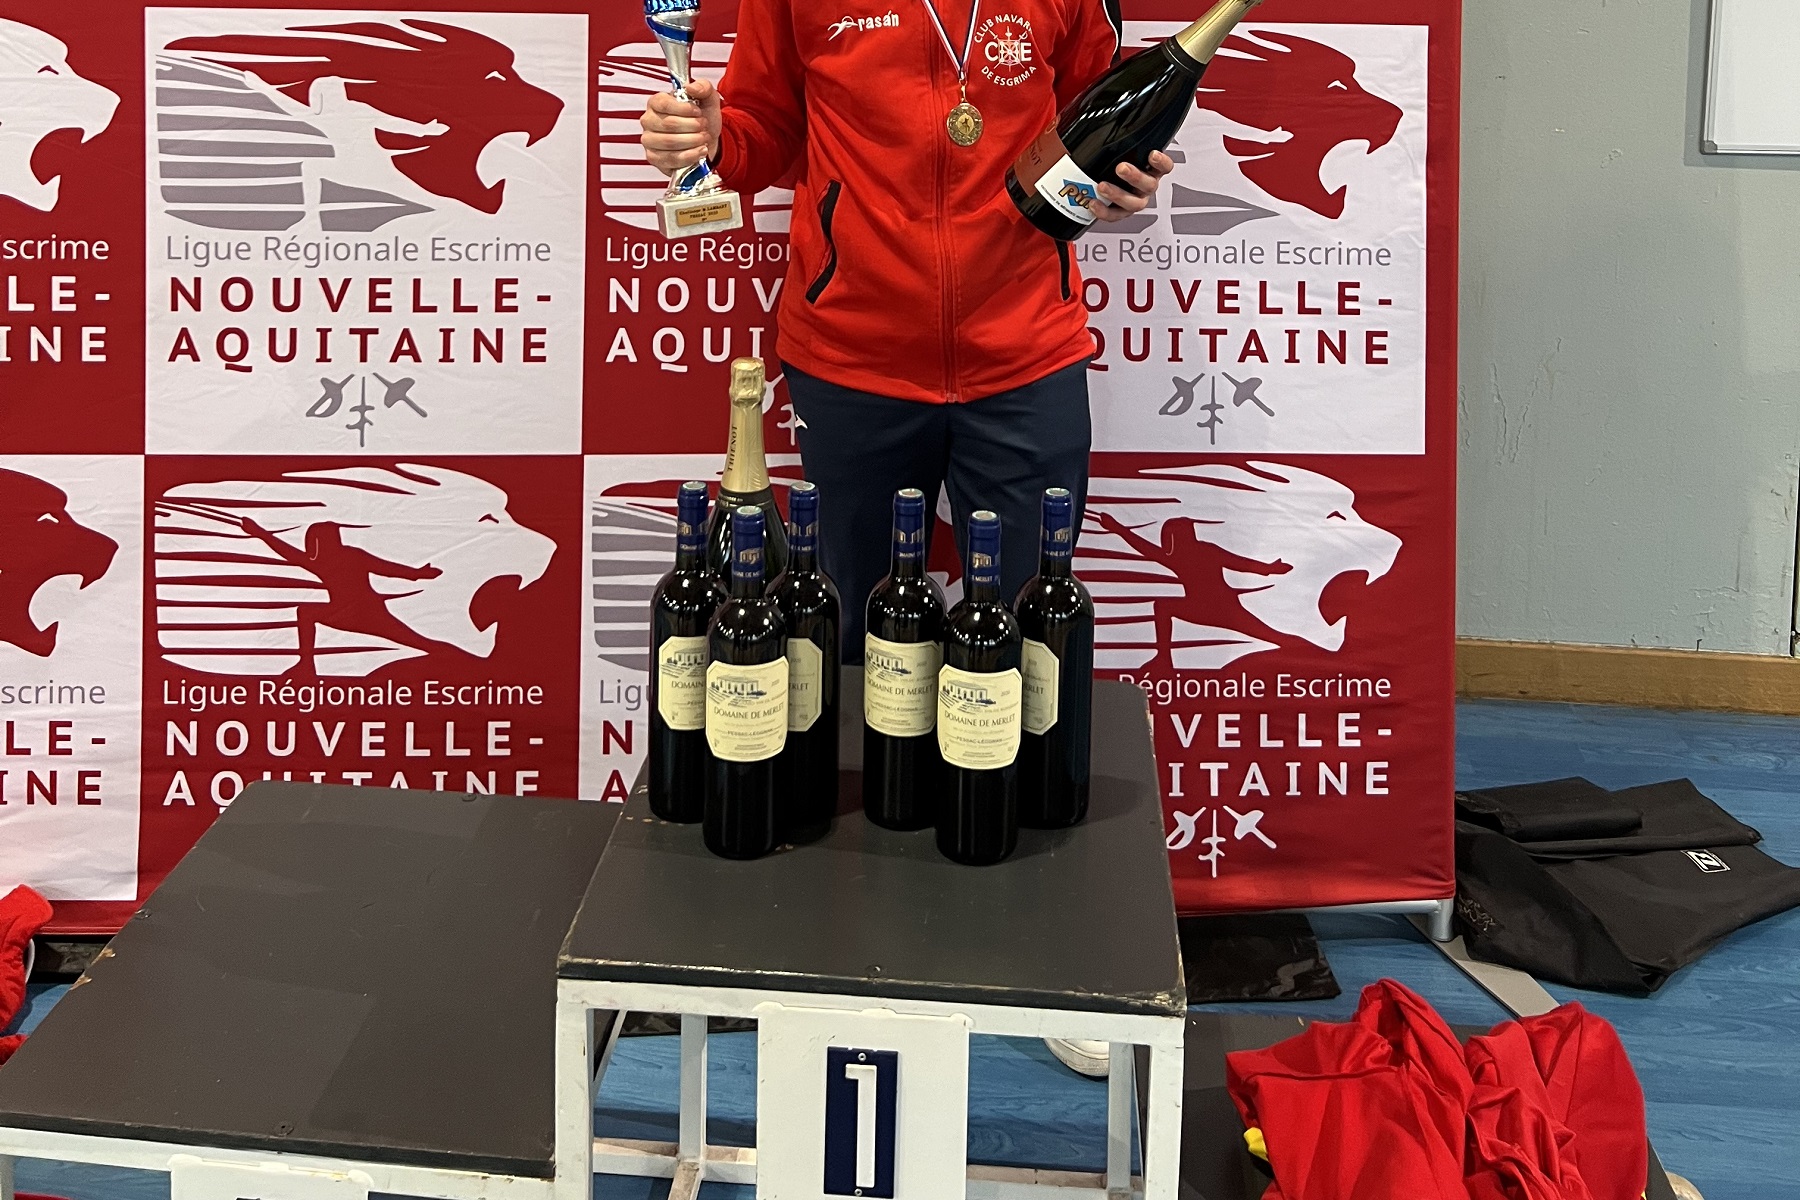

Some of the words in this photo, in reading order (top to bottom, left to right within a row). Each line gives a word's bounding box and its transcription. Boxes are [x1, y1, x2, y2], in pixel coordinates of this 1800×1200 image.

[974, 18, 994, 43] CLUB
[995, 13, 1033, 34] NAVAR
[981, 65, 994, 80] DE
[993, 66, 1037, 86] ESGRIMA
[0, 233, 110, 260] scrime
[166, 235, 252, 268] Ligue
[263, 234, 419, 269] Régionale
[431, 237, 552, 263] Escrime
[606, 237, 688, 270] Ligue
[700, 236, 790, 270] Régio
[1119, 237, 1265, 270] Régionale
[1276, 241, 1392, 266] Escrime
[8, 275, 110, 312] LE-
[170, 276, 552, 314] NOUVELLE-
[608, 277, 784, 313] NOUV
[1082, 277, 1393, 315] OUVELLE-
[0, 325, 107, 362] INE
[168, 326, 549, 373] AQUITAINE
[605, 327, 765, 373] AQUI
[1086, 326, 1389, 372] QUITAINE
[0, 679, 106, 704] scrime
[162, 679, 248, 713] Ligue
[259, 679, 411, 713] Régionale
[424, 682, 544, 706] Escrime
[600, 679, 650, 711] Lig
[672, 680, 704, 688] DOMAIN
[1277, 673, 1391, 698] Escrime
[714, 705, 749, 719] DOMAINE
[751, 711, 761, 719] DE
[763, 701, 784, 716] MERLET
[945, 710, 977, 726] DOMAINE
[992, 713, 1016, 726] MERLET
[6, 720, 106, 755] LE-
[166, 720, 544, 758] NOUVELLE-
[1149, 712, 1392, 748] VELLE-
[0, 770, 102, 806] INE
[1168, 761, 1389, 796] ITAINE
[845, 1063, 877, 1188] 1
